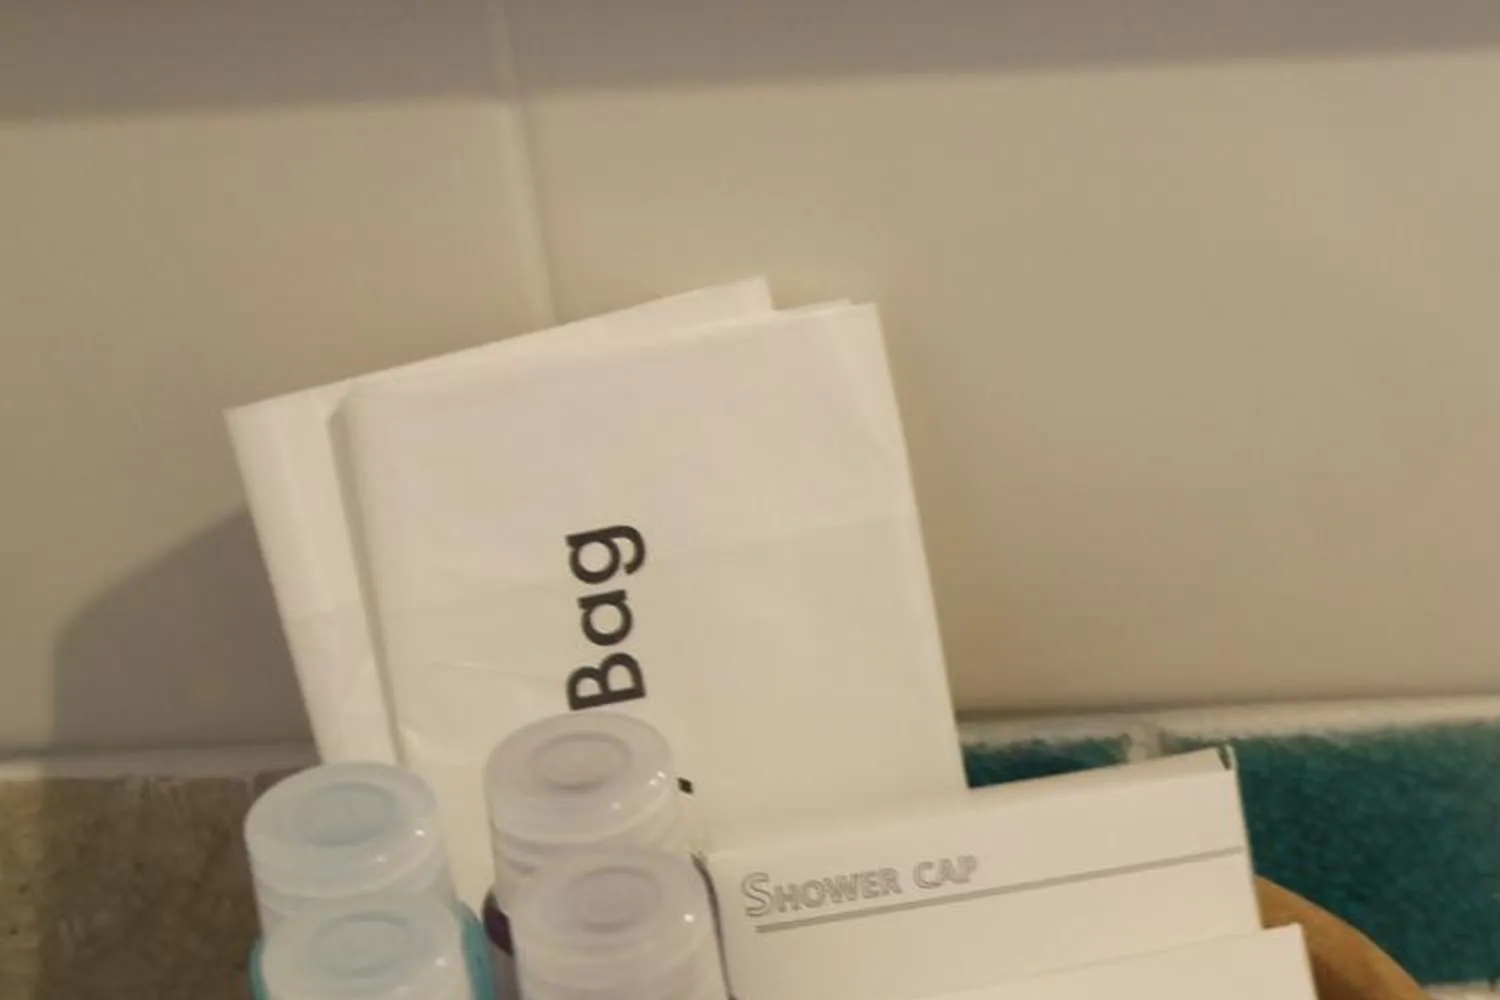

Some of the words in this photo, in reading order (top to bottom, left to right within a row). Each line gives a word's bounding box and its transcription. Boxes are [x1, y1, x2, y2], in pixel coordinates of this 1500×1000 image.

[565, 524, 647, 711] Bag
[741, 868, 903, 918] SHOWER
[912, 854, 978, 889] CAP
